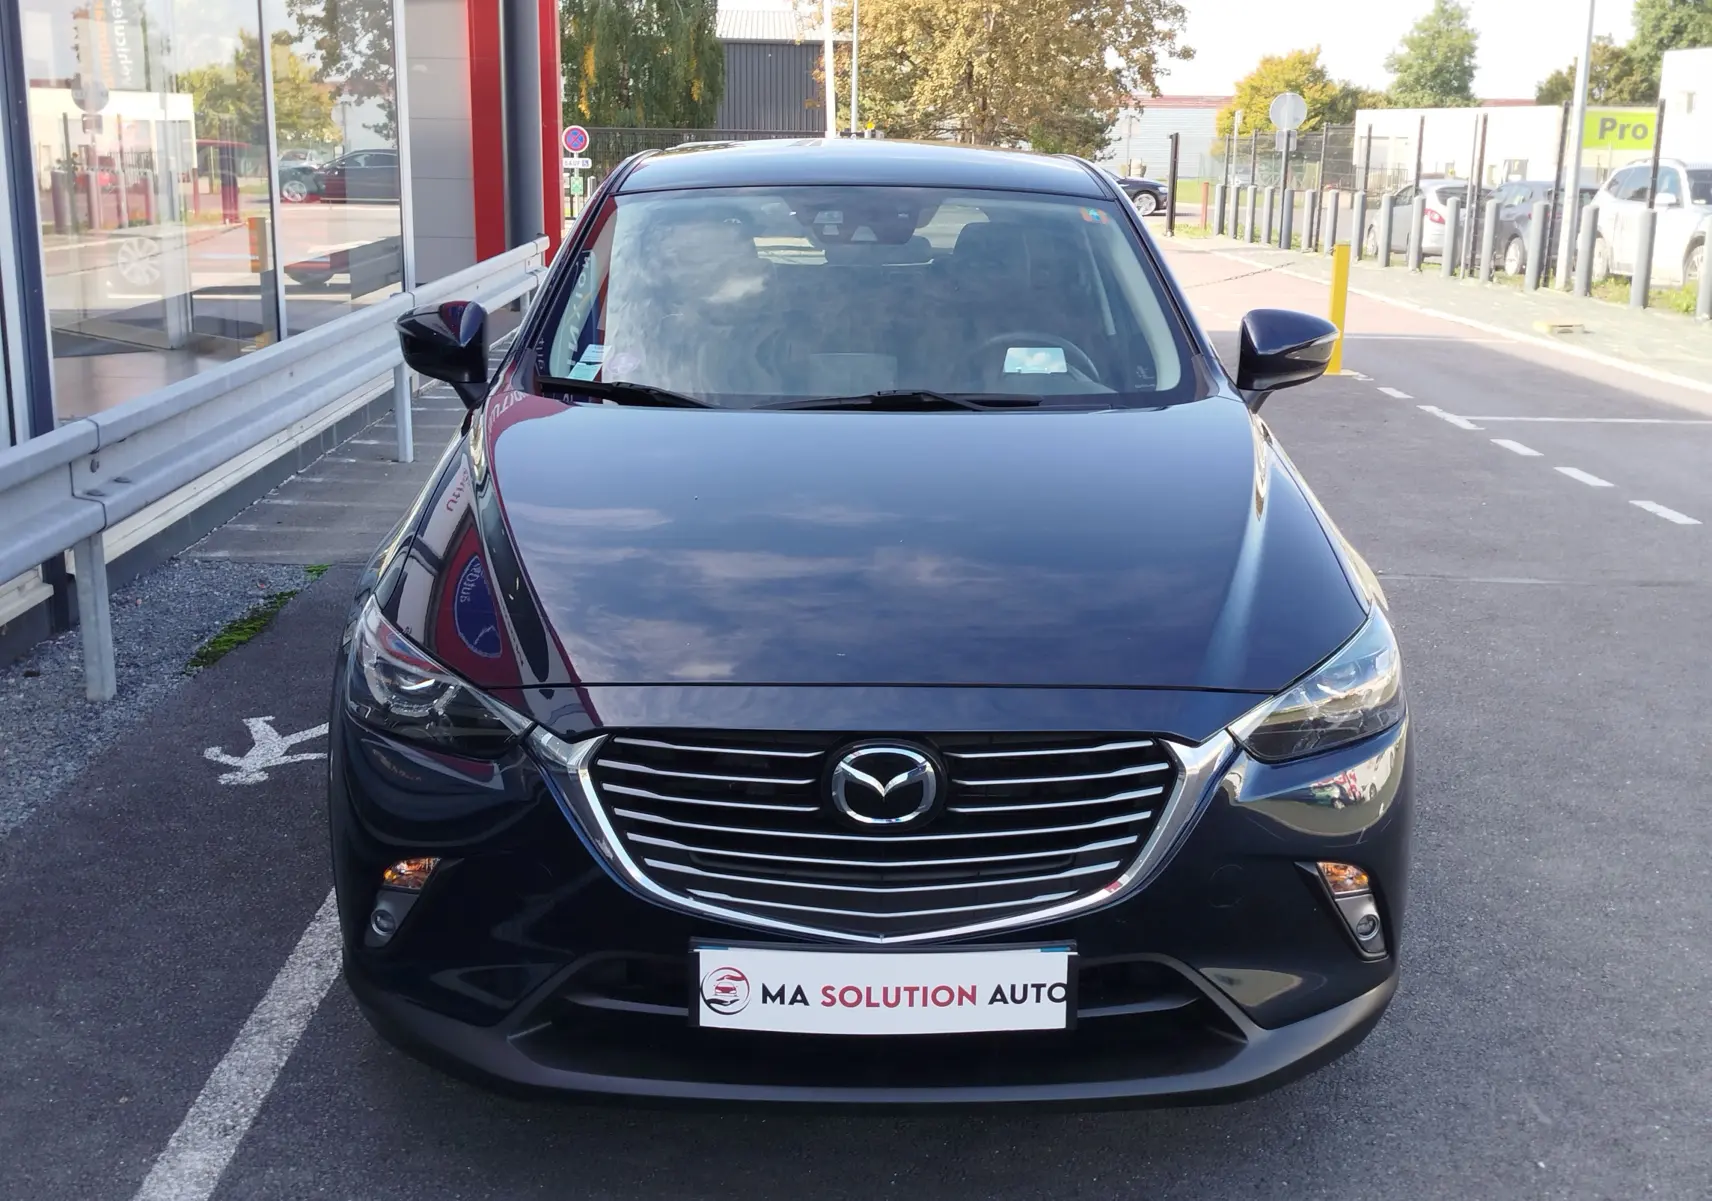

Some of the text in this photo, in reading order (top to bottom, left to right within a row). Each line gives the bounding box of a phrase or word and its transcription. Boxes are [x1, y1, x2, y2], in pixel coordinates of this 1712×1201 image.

[1599, 117, 1648, 140] Pro
[761, 982, 1068, 1008] MA SOLUTION AUTO
